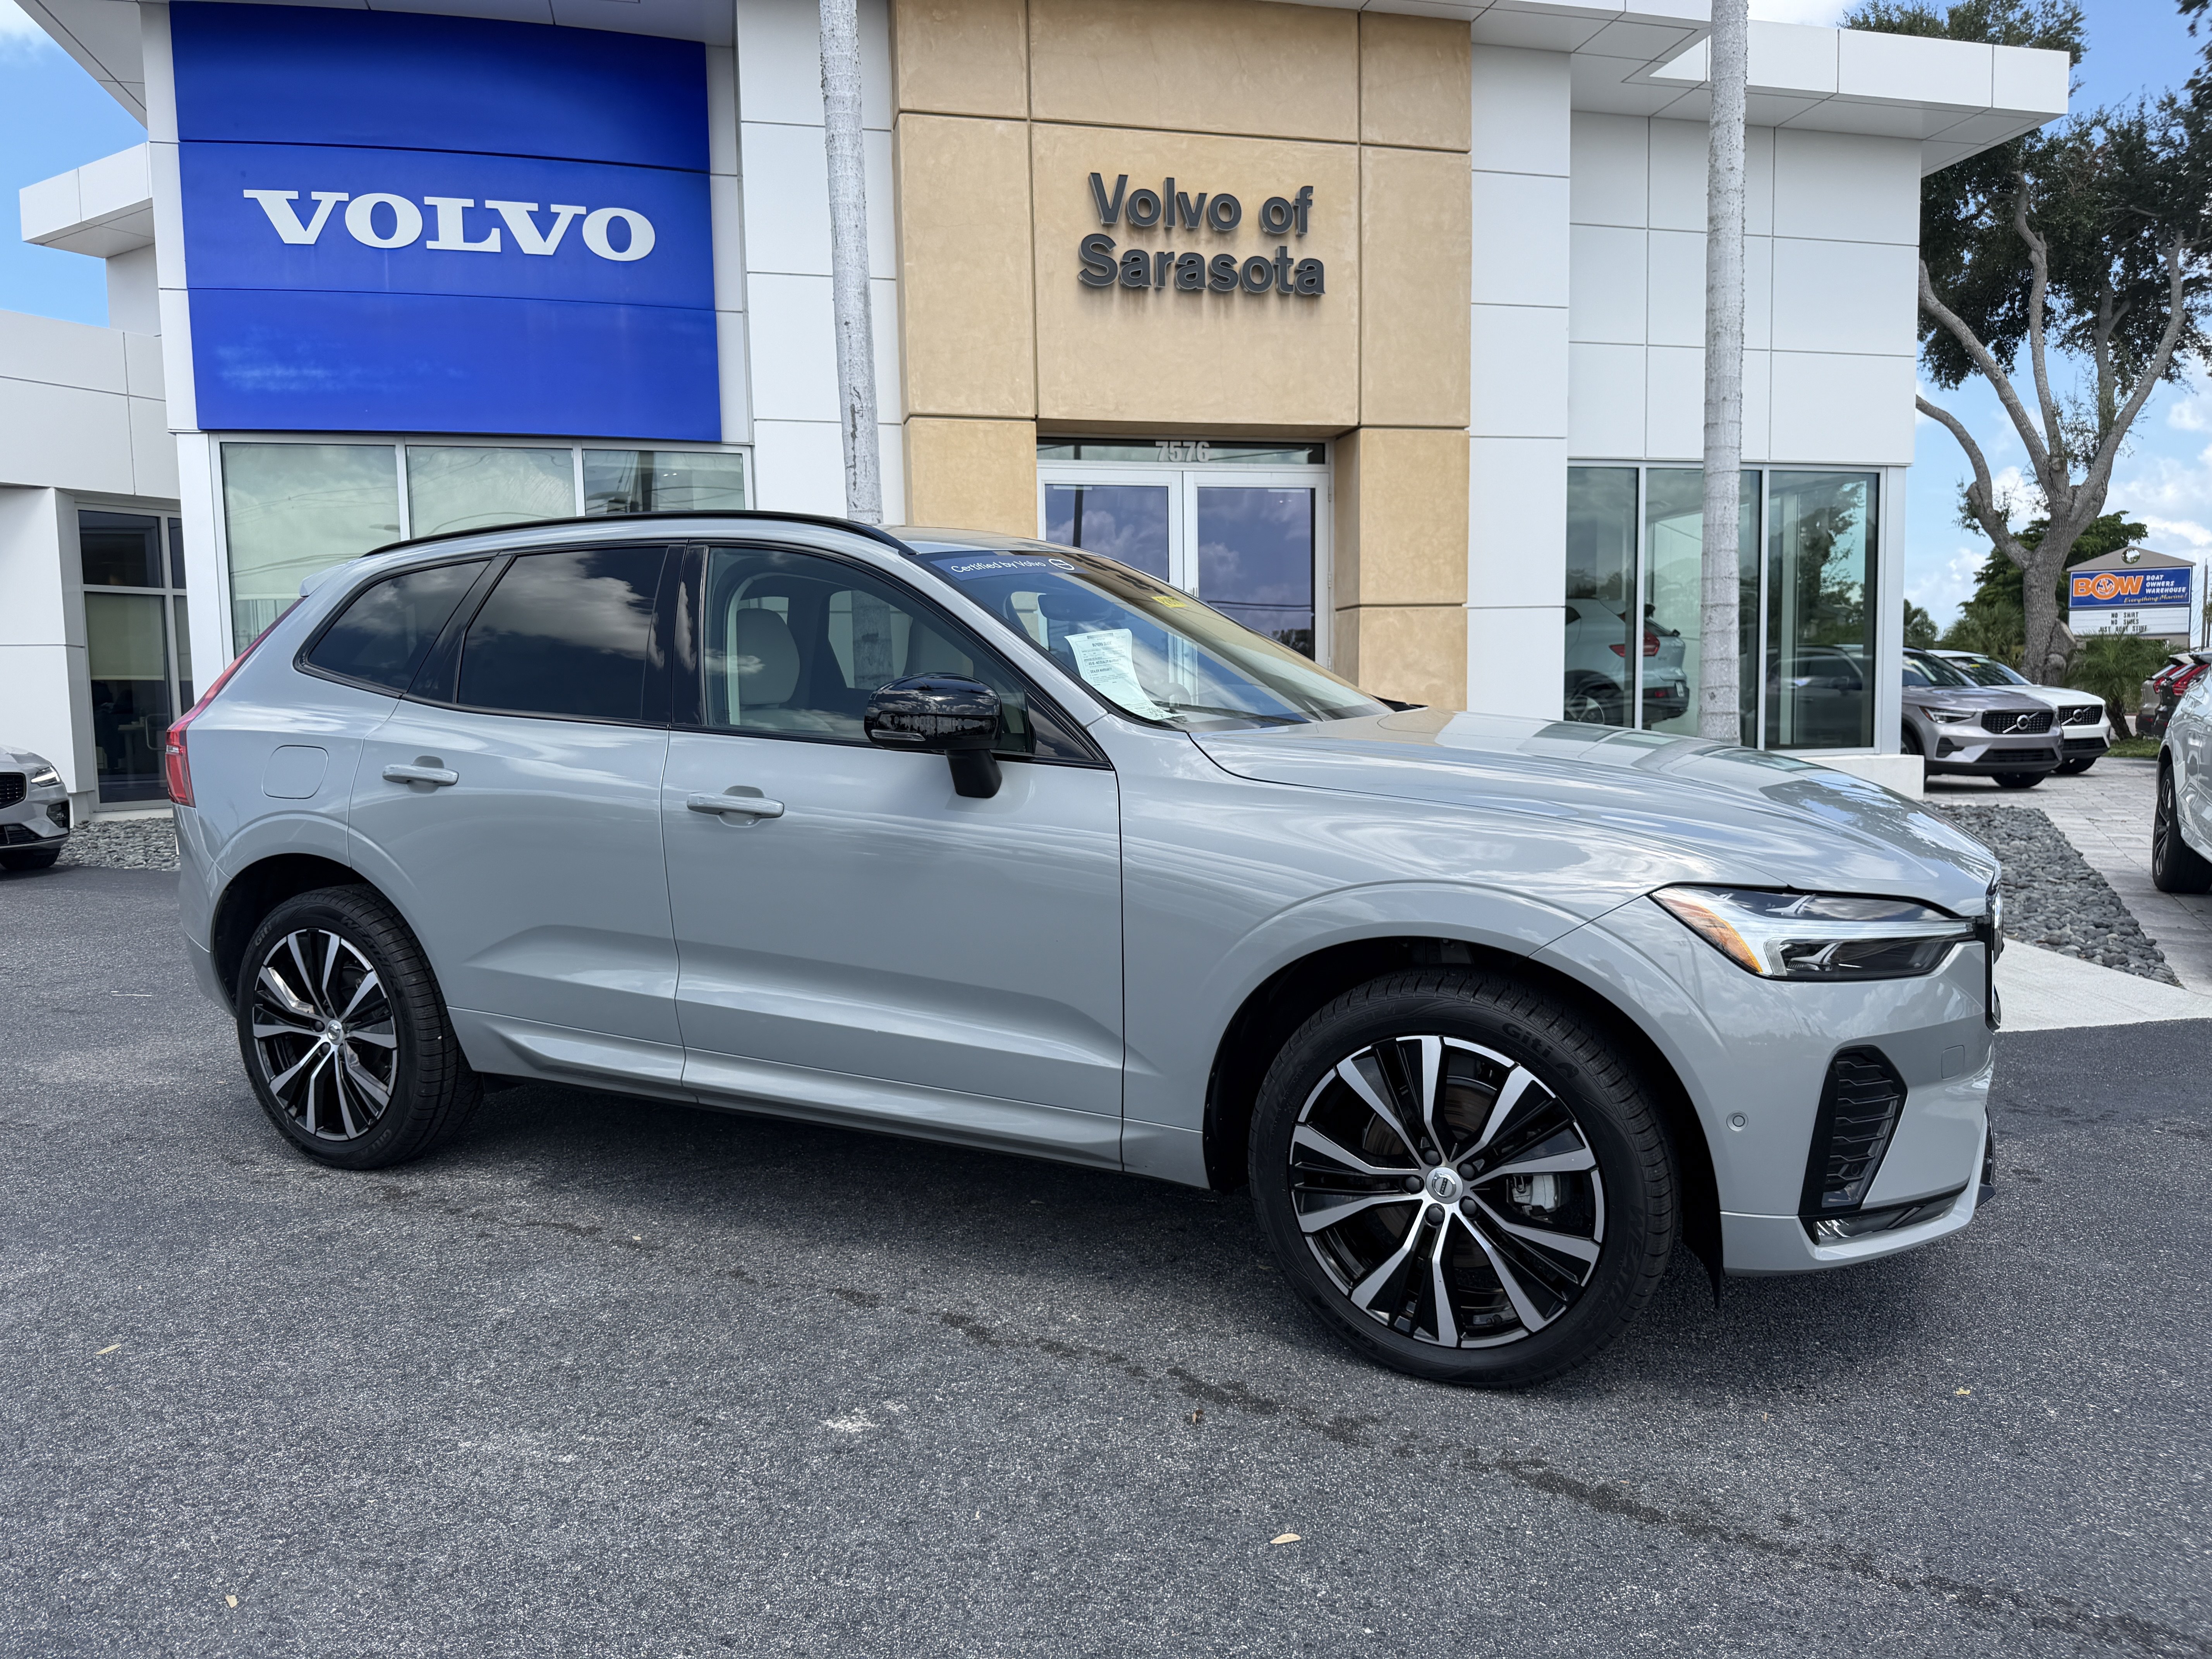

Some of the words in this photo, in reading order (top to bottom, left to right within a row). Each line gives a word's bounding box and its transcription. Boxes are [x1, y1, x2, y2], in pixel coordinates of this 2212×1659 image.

[1088, 172, 1242, 232] Volvo
[1259, 186, 1313, 237] of
[244, 189, 655, 261] VOLVO
[1078, 233, 1325, 295] Sarasota
[1156, 441, 1209, 462] 7576
[951, 562, 1002, 572] Certified
[2073, 573, 2143, 600] BOW
[1502, 1023, 1555, 1059] Giti
